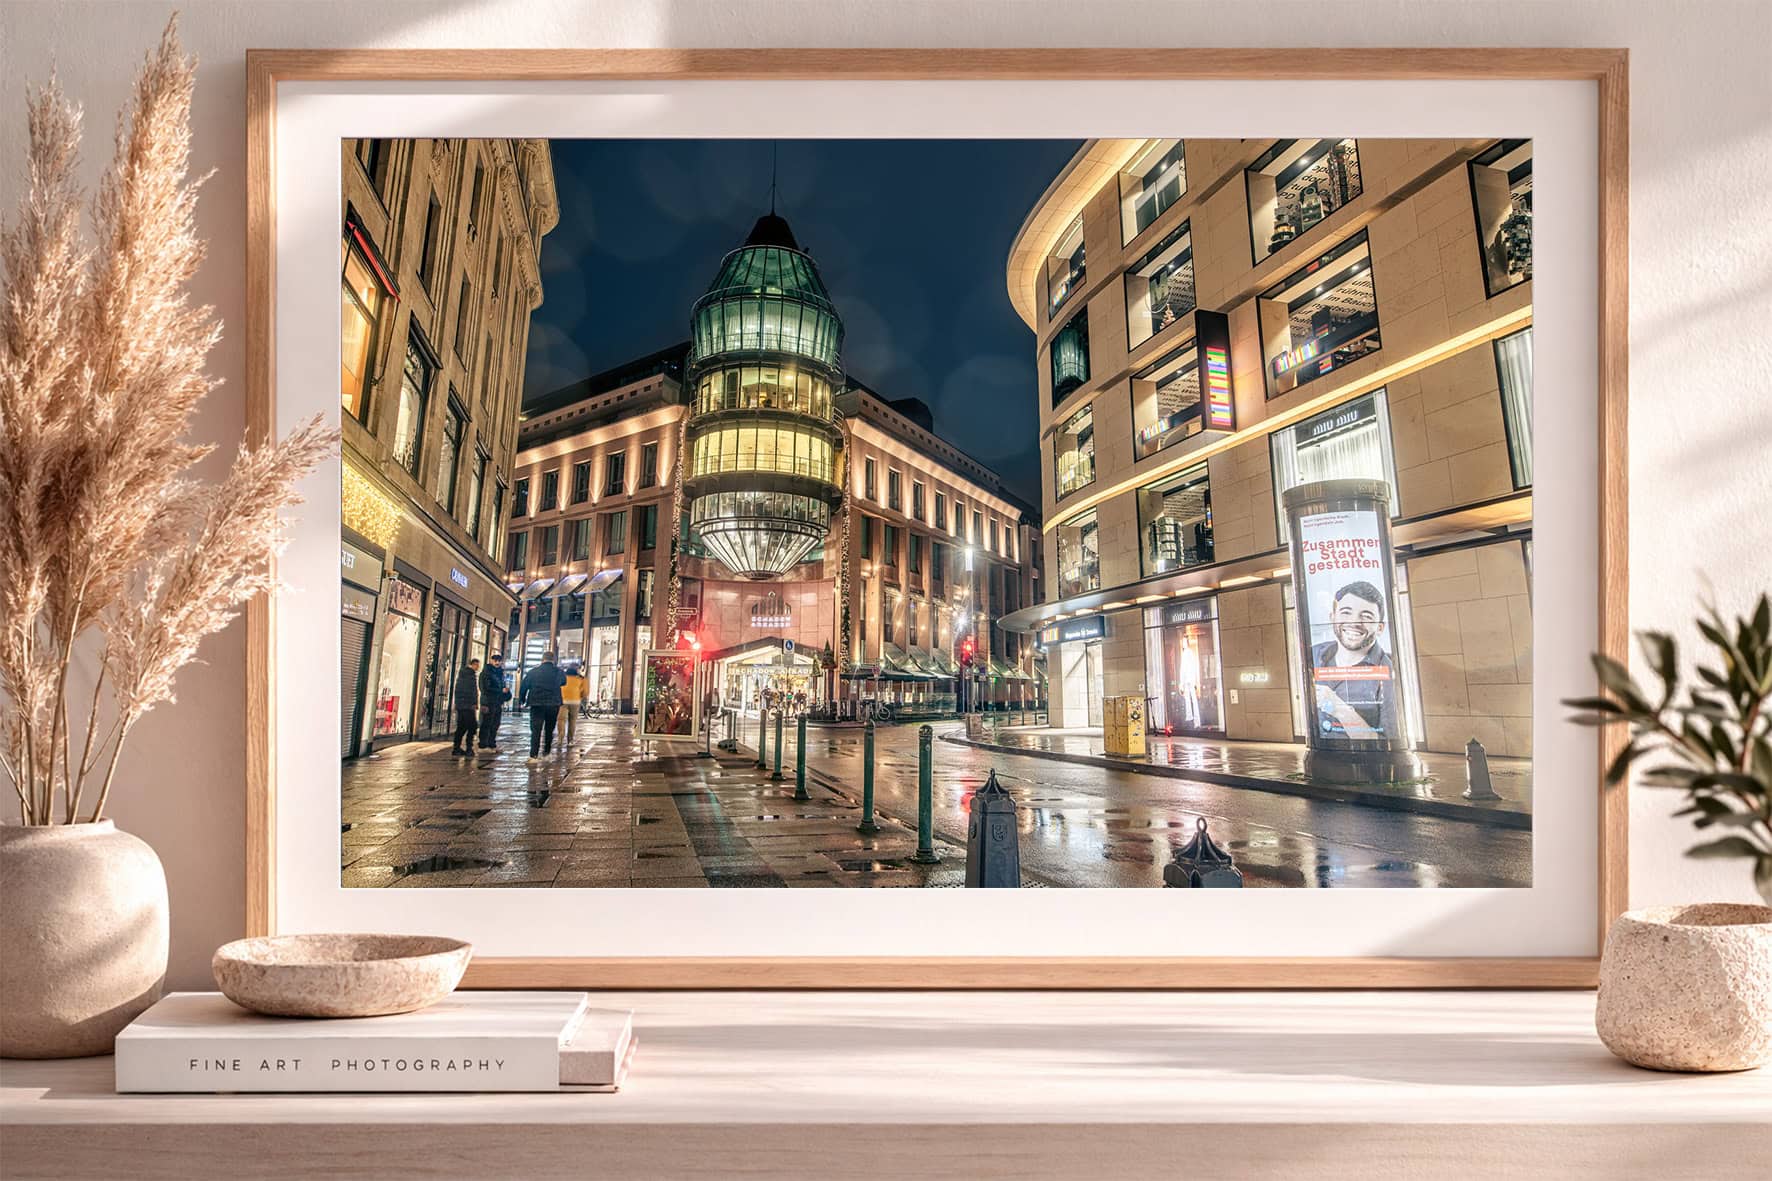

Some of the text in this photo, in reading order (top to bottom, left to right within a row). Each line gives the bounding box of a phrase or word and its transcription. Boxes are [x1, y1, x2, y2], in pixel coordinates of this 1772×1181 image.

[1320, 546, 1365, 560] Stadt
[1308, 557, 1380, 575] gestalten
[190, 1059, 505, 1072] FINE ART PHOTOGRAPHY
